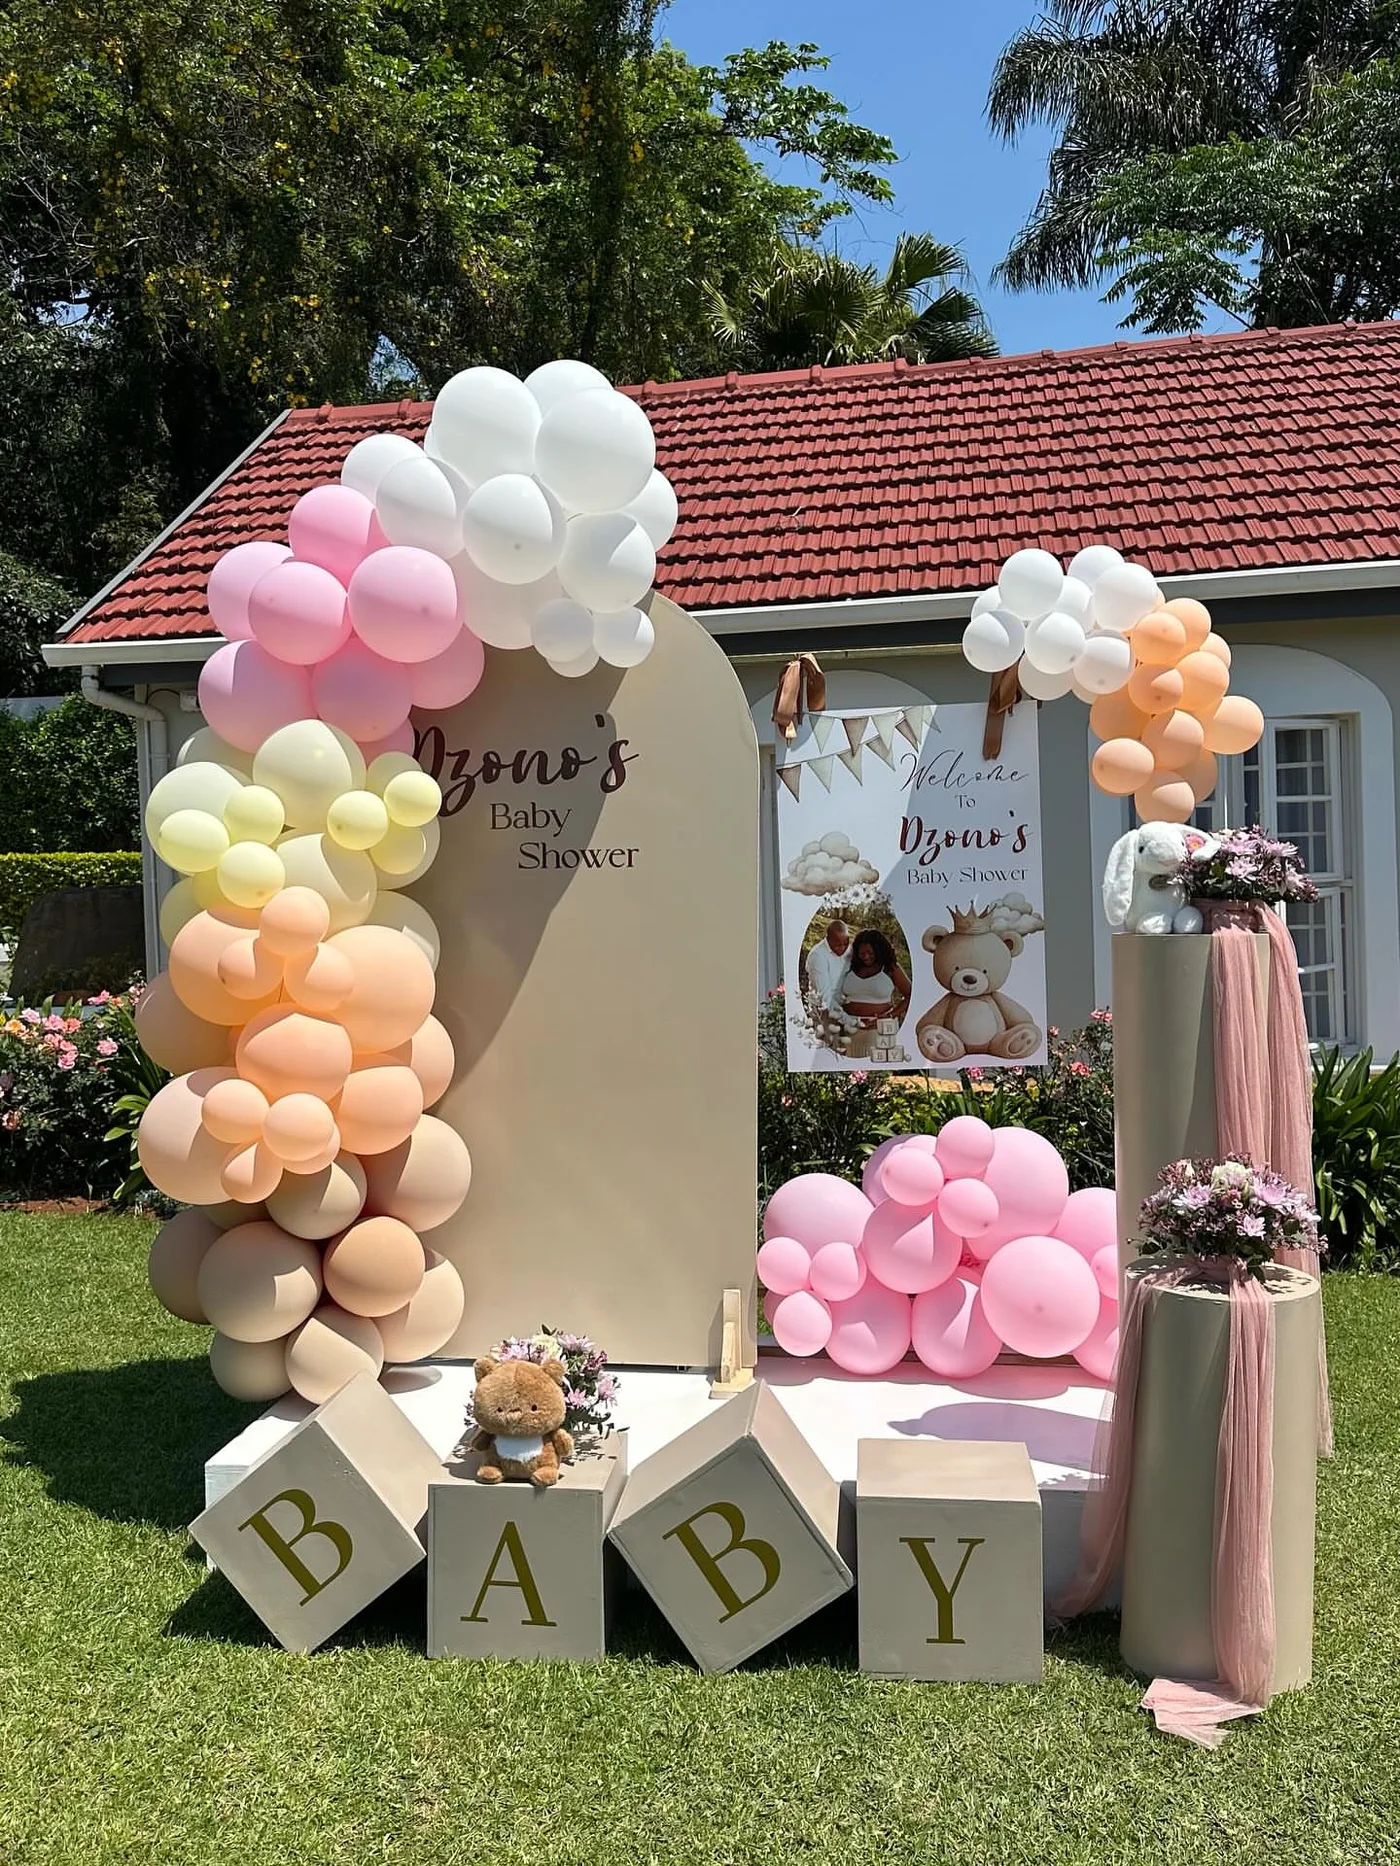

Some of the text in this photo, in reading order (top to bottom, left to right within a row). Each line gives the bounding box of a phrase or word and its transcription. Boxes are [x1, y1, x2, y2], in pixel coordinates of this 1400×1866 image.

[900, 749, 1029, 791] Welcome
[955, 794, 976, 809] To
[490, 802, 572, 837] Baby
[900, 809, 1034, 866] Dzono's
[518, 842, 640, 870] Shower
[907, 867, 1028, 889] Baby Shower
